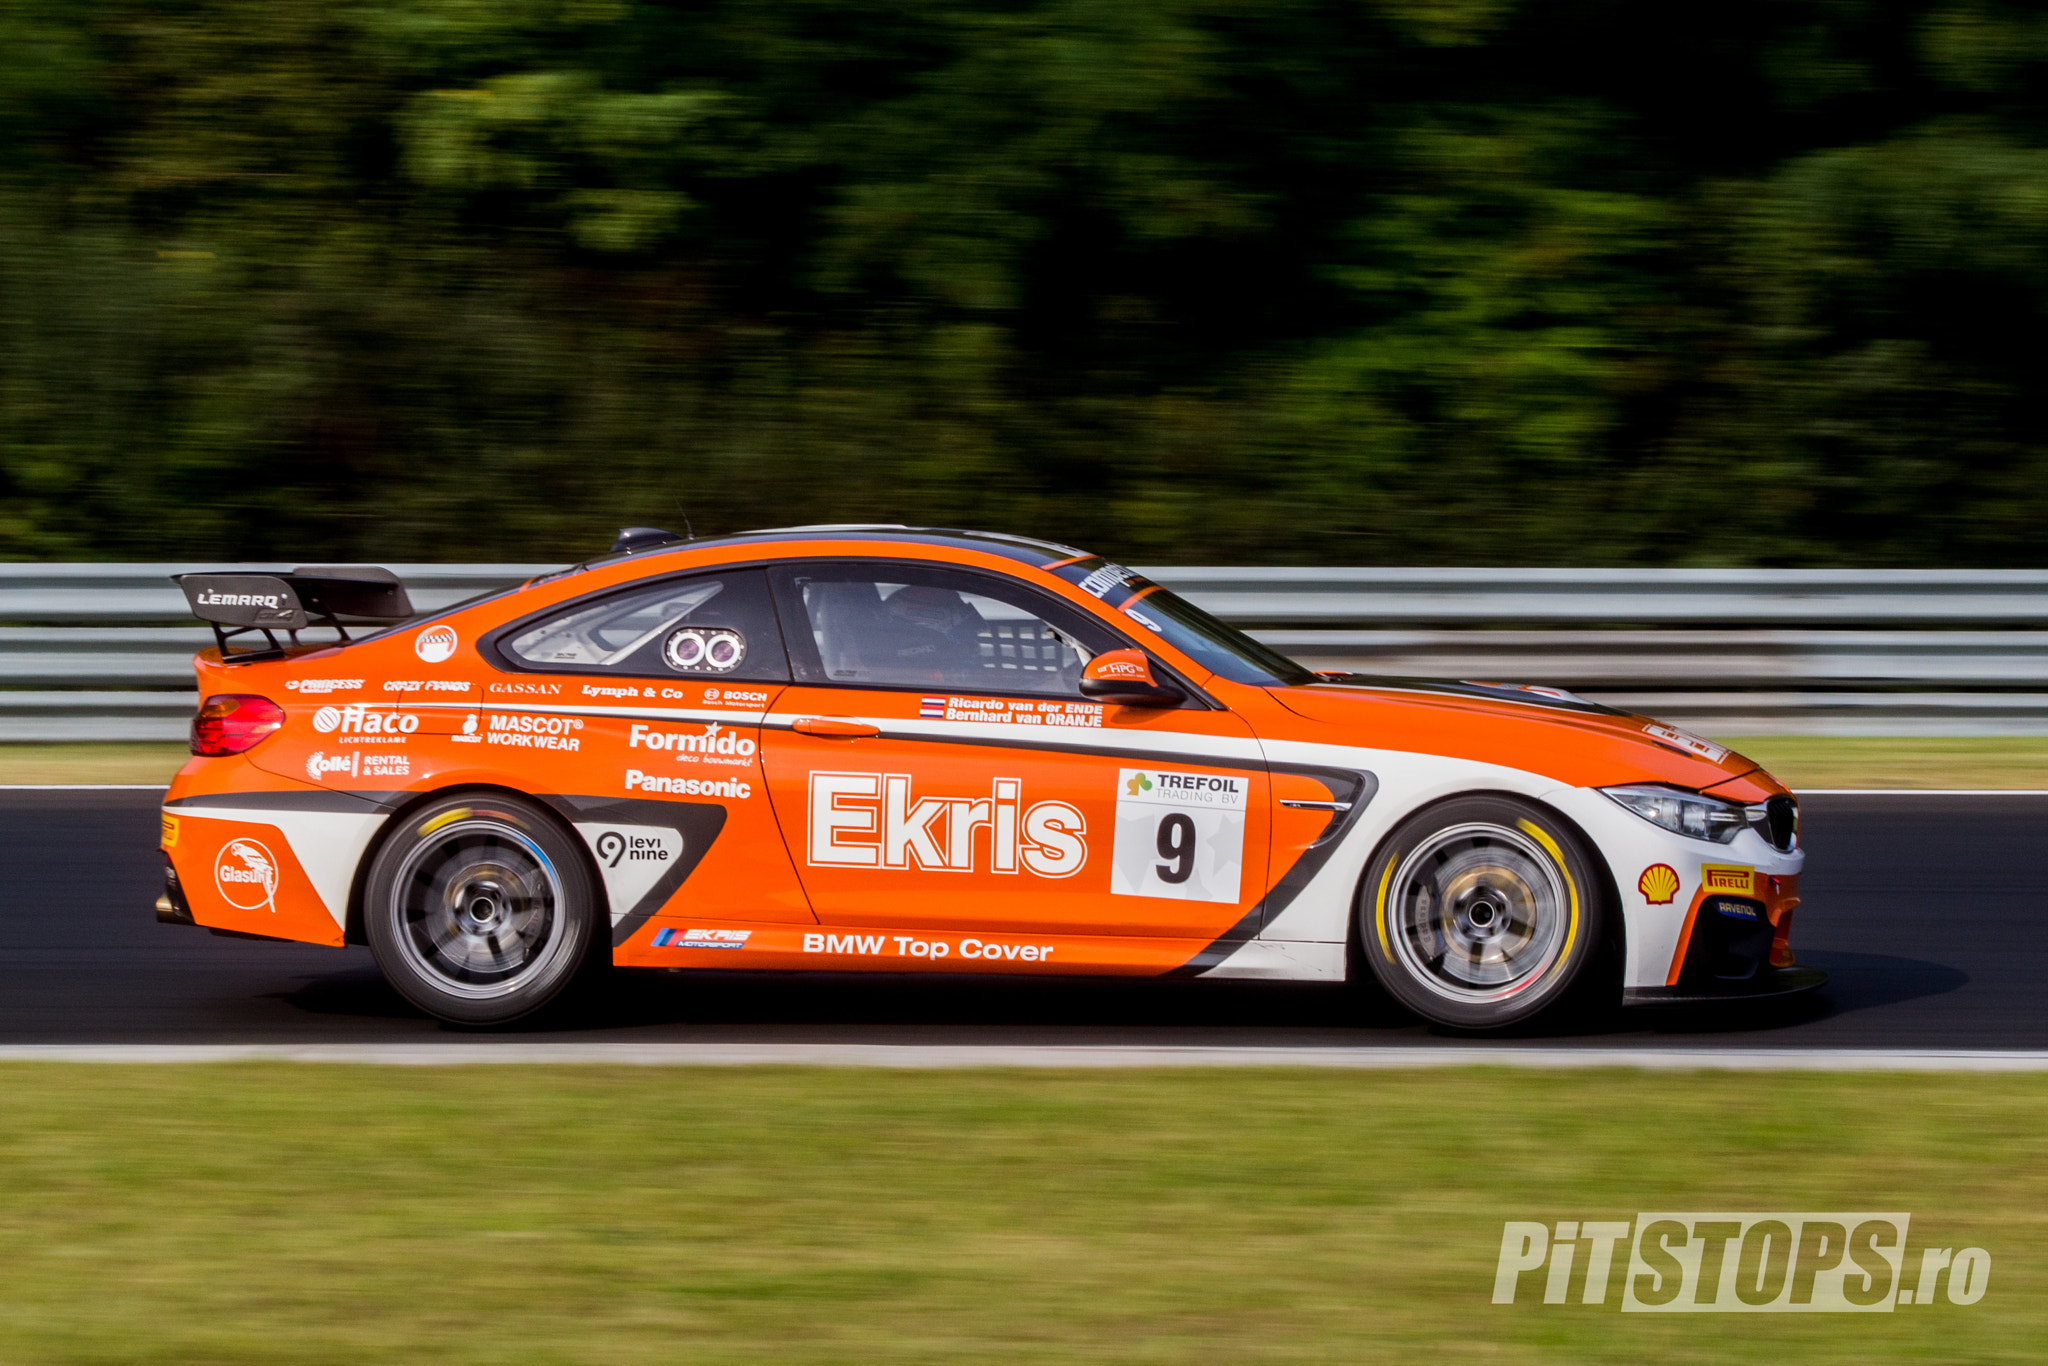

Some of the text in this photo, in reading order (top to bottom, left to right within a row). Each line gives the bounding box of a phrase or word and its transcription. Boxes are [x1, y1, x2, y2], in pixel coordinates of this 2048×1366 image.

[197, 593, 279, 609] LEMARQ
[1124, 608, 1162, 633] 9
[1109, 664, 1136, 674] HPG
[300, 679, 366, 689] PRINCESS
[383, 680, 425, 691] CRAZY
[489, 683, 562, 695] GASSAN
[581, 684, 684, 699] Lymph & Co
[723, 690, 767, 702] BOSCH
[948, 697, 1104, 715] Ricardo van der ENDE
[340, 706, 419, 734] Haco
[945, 708, 1103, 728] Bernhard van ORANJE
[338, 736, 407, 744] LICHTREKLAME
[487, 731, 580, 752] WORKWEAR
[629, 723, 756, 756] Formido
[364, 755, 410, 765] RENTAL
[362, 765, 410, 776] & SALES
[624, 768, 751, 799] Panasonic
[1157, 774, 1240, 793] TREFOIL
[1156, 788, 1239, 805] TRADING BV
[806, 770, 1088, 879] Ekris
[629, 835, 661, 849] levi
[1155, 812, 1197, 884] 9
[629, 849, 669, 860] nine
[1706, 869, 1750, 890] PIRELLI
[1718, 902, 1756, 916] RAVENOL
[683, 928, 753, 941] EKRIS
[677, 940, 744, 950] MOTORSPORT
[803, 933, 1054, 962] BMW Top Cover
